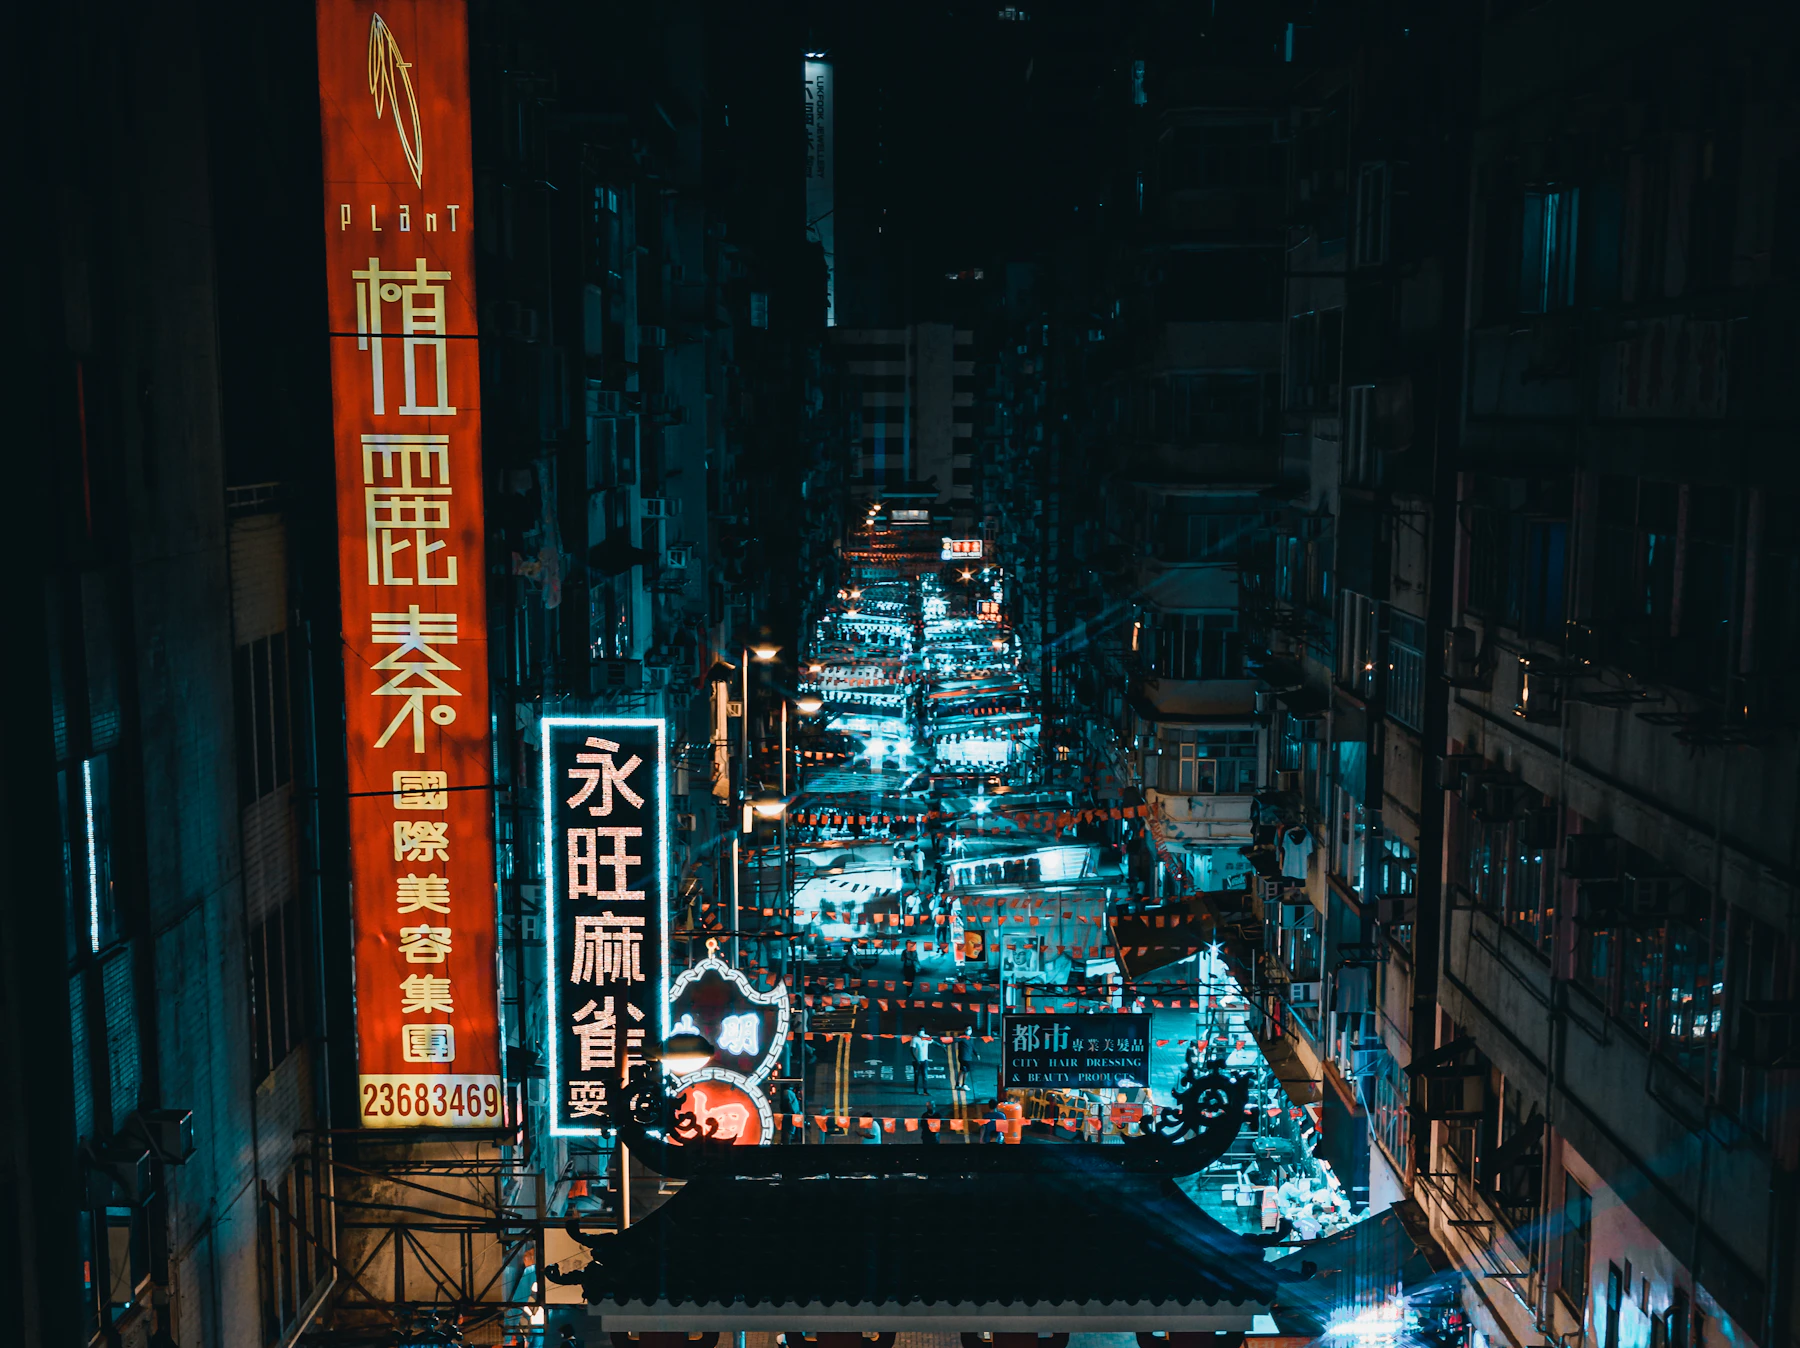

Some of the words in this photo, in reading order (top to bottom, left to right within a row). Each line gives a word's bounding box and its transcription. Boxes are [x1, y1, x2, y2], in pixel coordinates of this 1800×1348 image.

[392, 769, 456, 1063] 國際美容集團
[567, 735, 647, 1072] 永旺麻雀
[1012, 1023, 1071, 1053] 都市
[1012, 1058, 1040, 1067] CITY
[1049, 1058, 1079, 1067] HAIR
[1086, 1058, 1142, 1068] DRESSING
[1012, 1073, 1021, 1082] &
[1028, 1073, 1070, 1082] BEAUTY
[1078, 1072, 1136, 1082] PRODUCTS
[363, 1079, 499, 1119] 23683469
